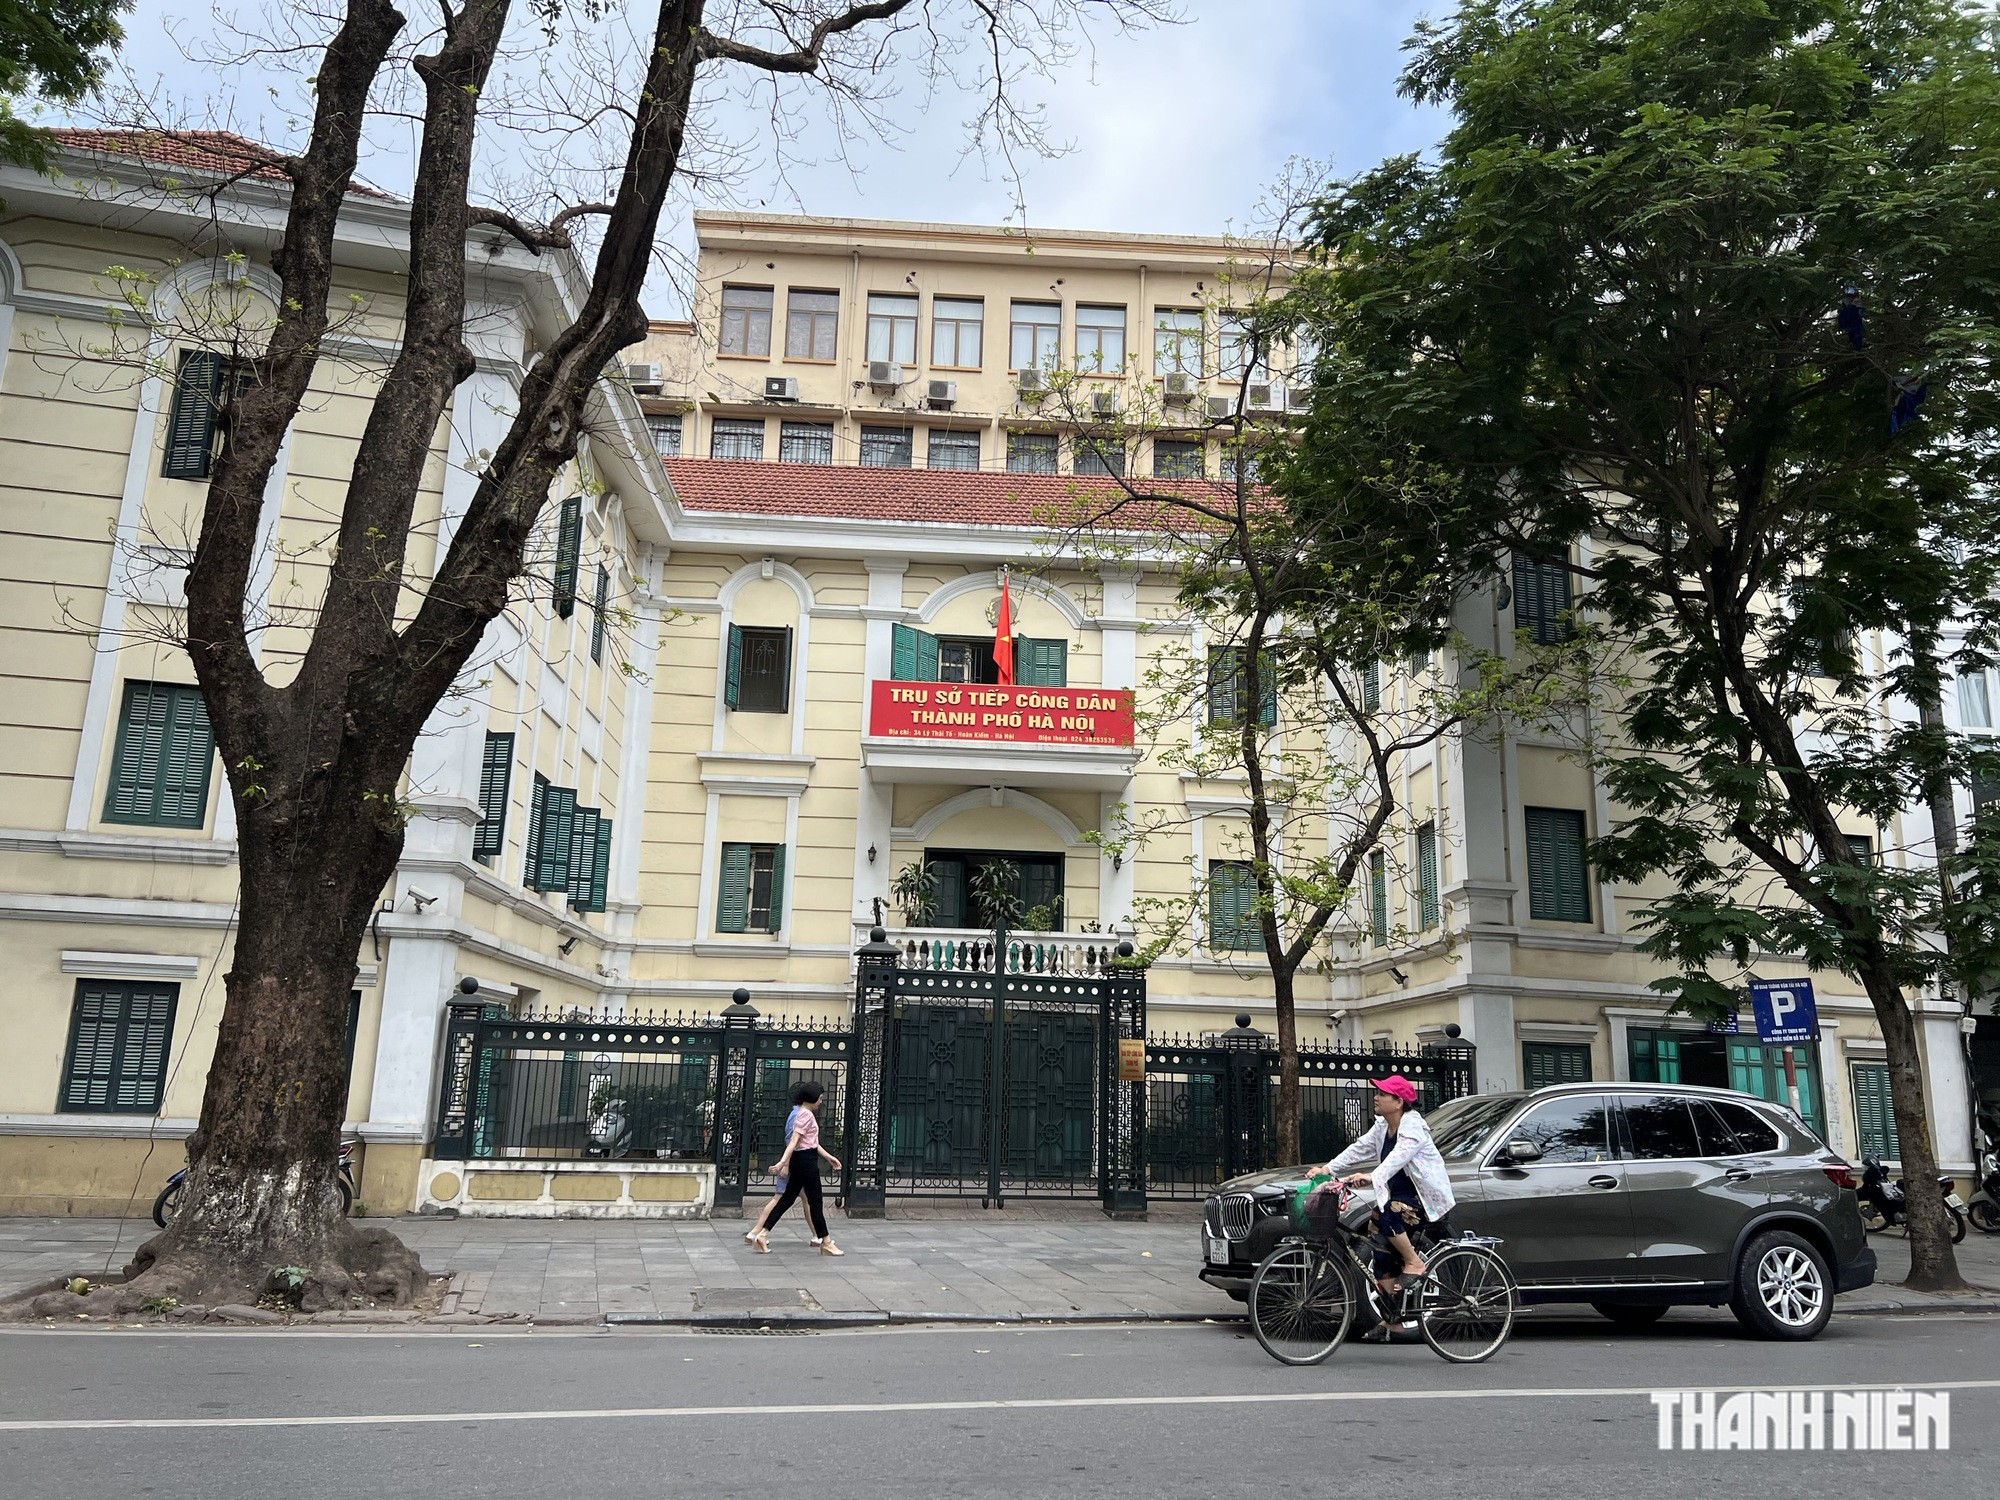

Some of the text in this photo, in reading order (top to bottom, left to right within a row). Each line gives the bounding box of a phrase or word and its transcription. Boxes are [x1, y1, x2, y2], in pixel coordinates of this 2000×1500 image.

[890, 686, 1116, 711] TRỤ SỞ TIẾP CÔNG DÂN
[911, 708, 1095, 734] THÀNH PHỐ HÀ NỘI
[923, 729, 930, 737] Lý
[931, 729, 944, 737] Thái
[1770, 991, 1796, 1026] P
